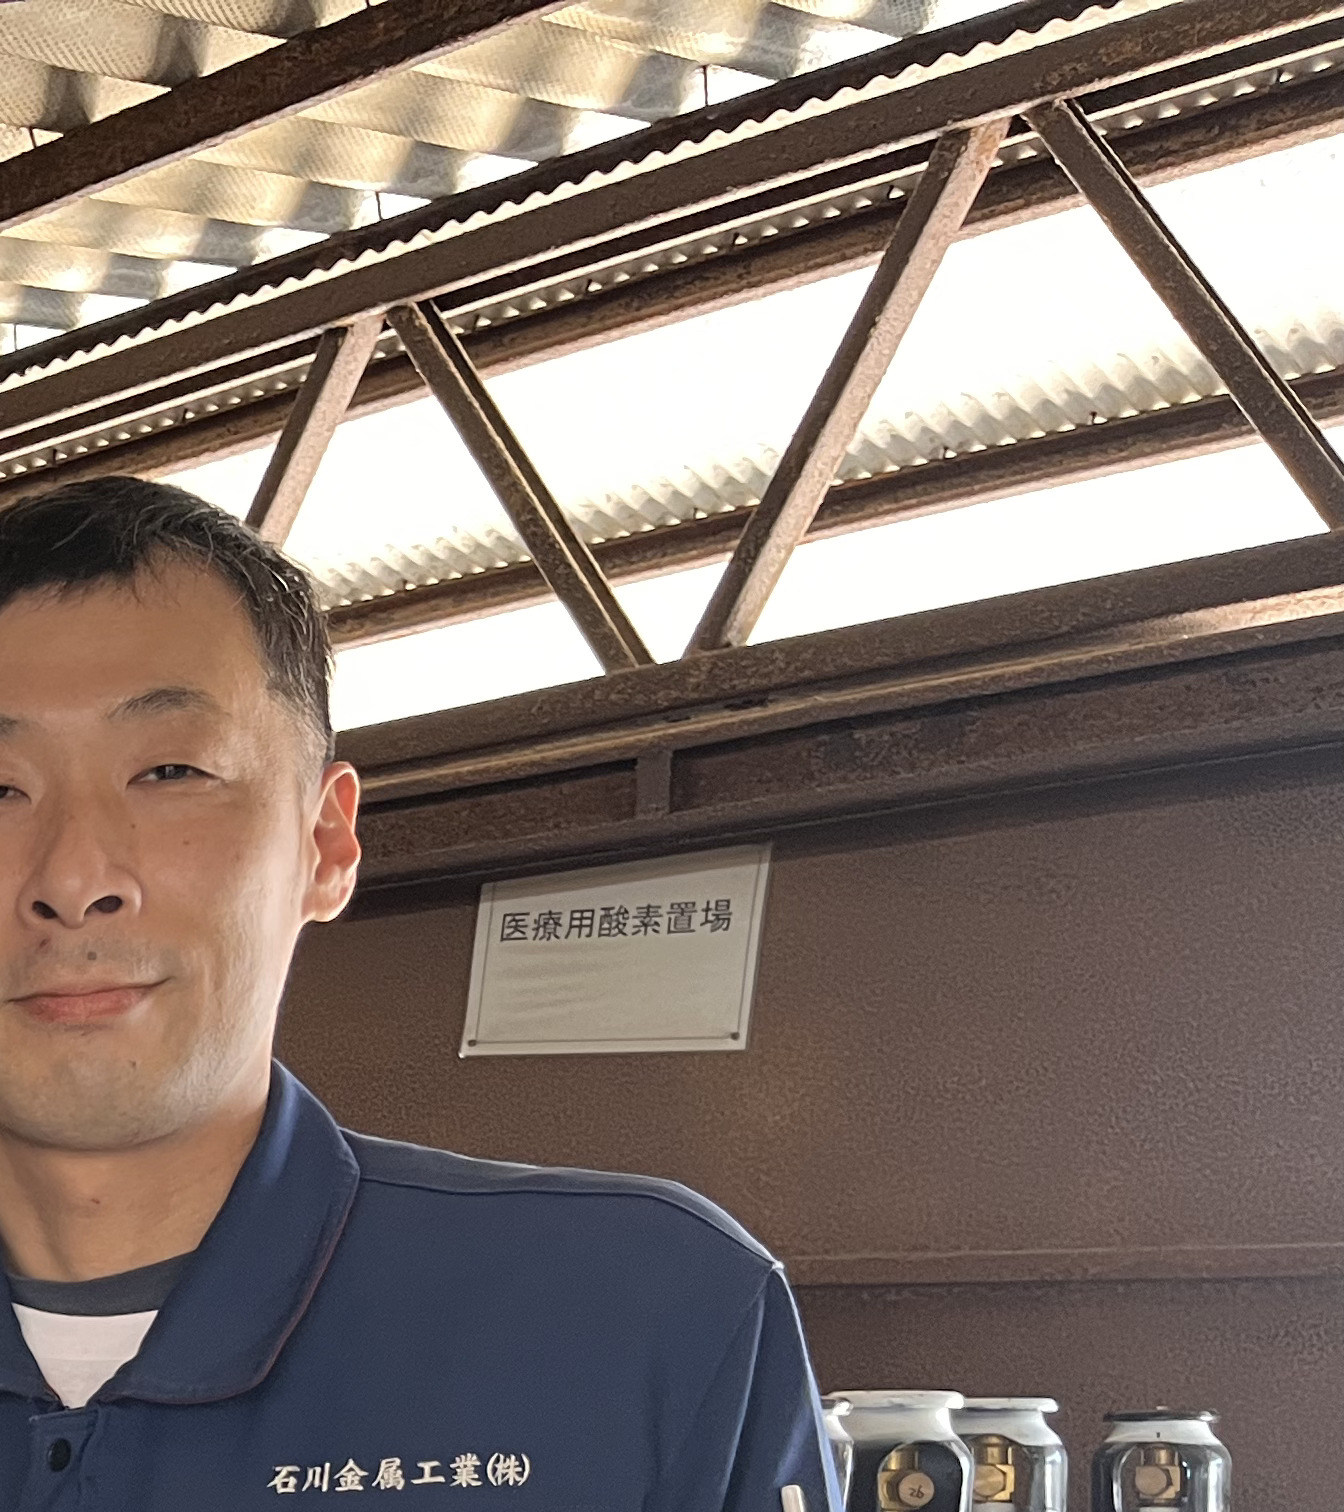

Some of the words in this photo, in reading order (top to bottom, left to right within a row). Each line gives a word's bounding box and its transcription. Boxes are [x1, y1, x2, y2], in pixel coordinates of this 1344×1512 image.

[499, 899, 733, 943] 医療用酸素置場
[267, 1452, 531, 1494] 石川金属工業(株)
